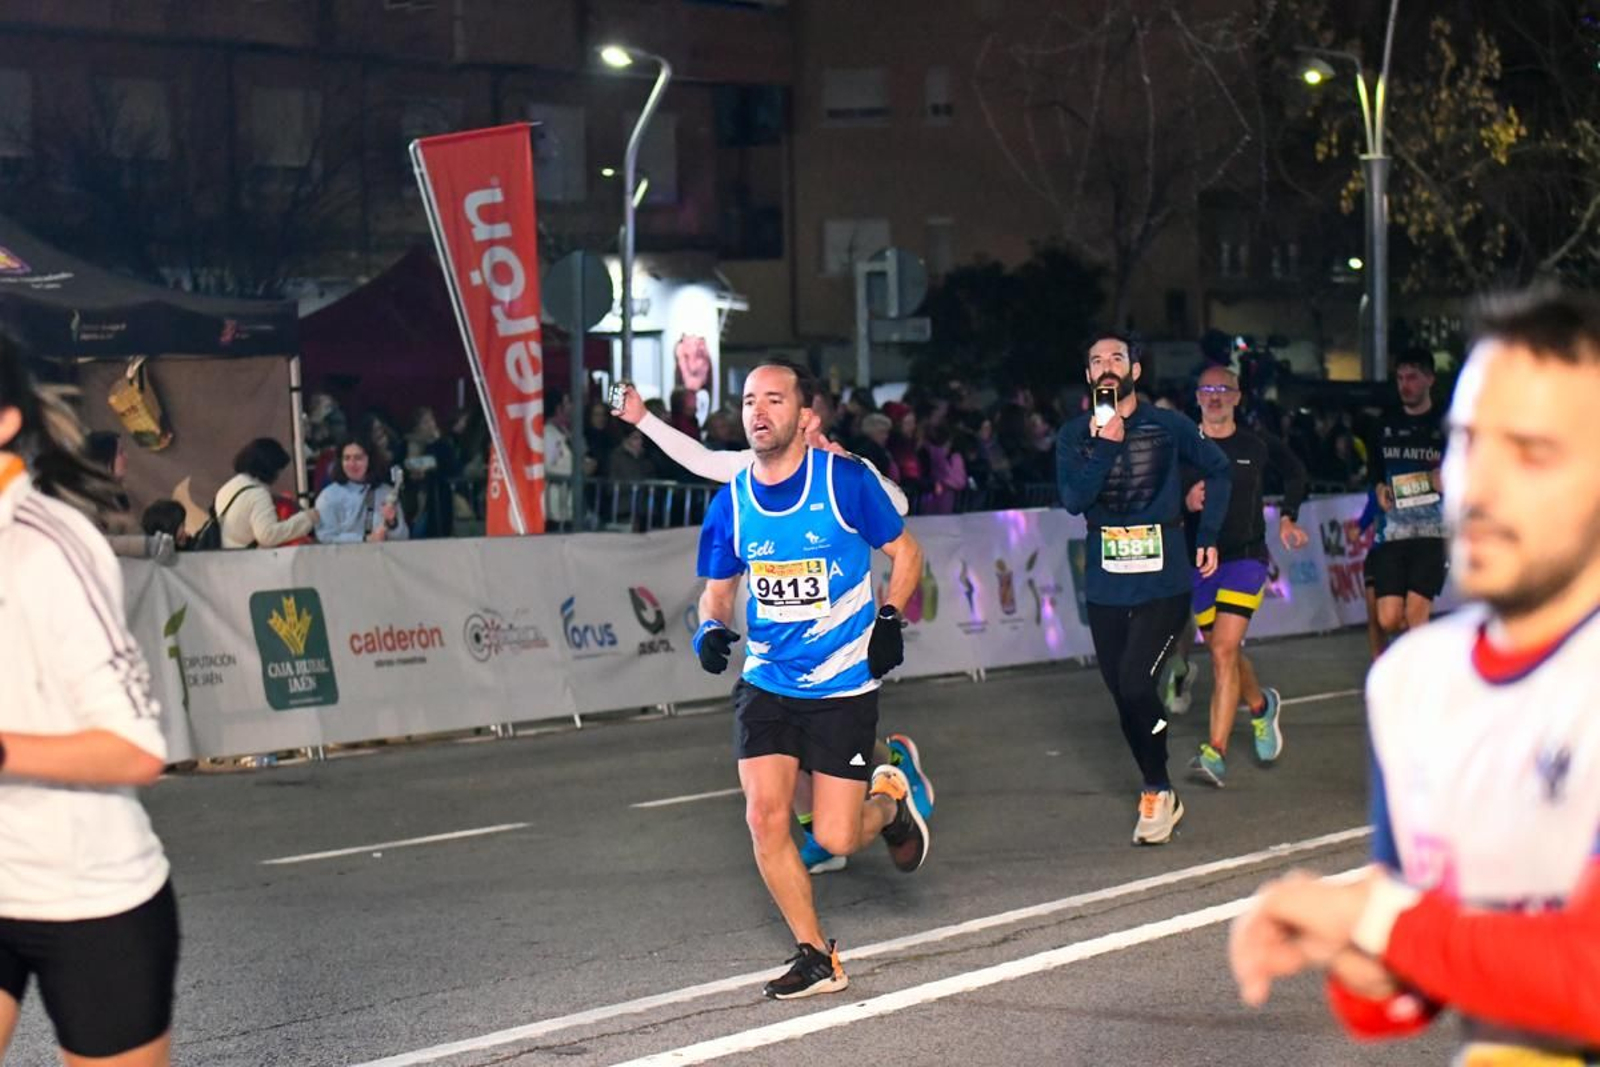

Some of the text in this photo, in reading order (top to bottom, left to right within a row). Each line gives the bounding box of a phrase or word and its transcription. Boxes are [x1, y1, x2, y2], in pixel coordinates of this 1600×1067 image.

[747, 540, 775, 559] Seli
[1107, 539, 1155, 556] 1581
[757, 576, 820, 599] 9413
[349, 621, 446, 655] calderón
[182, 652, 237, 669] DIPUTACIÓN
[267, 657, 330, 678] CAJA RURAL
[187, 672, 224, 687] DE JAÉN
[288, 675, 317, 694] JAÉN
